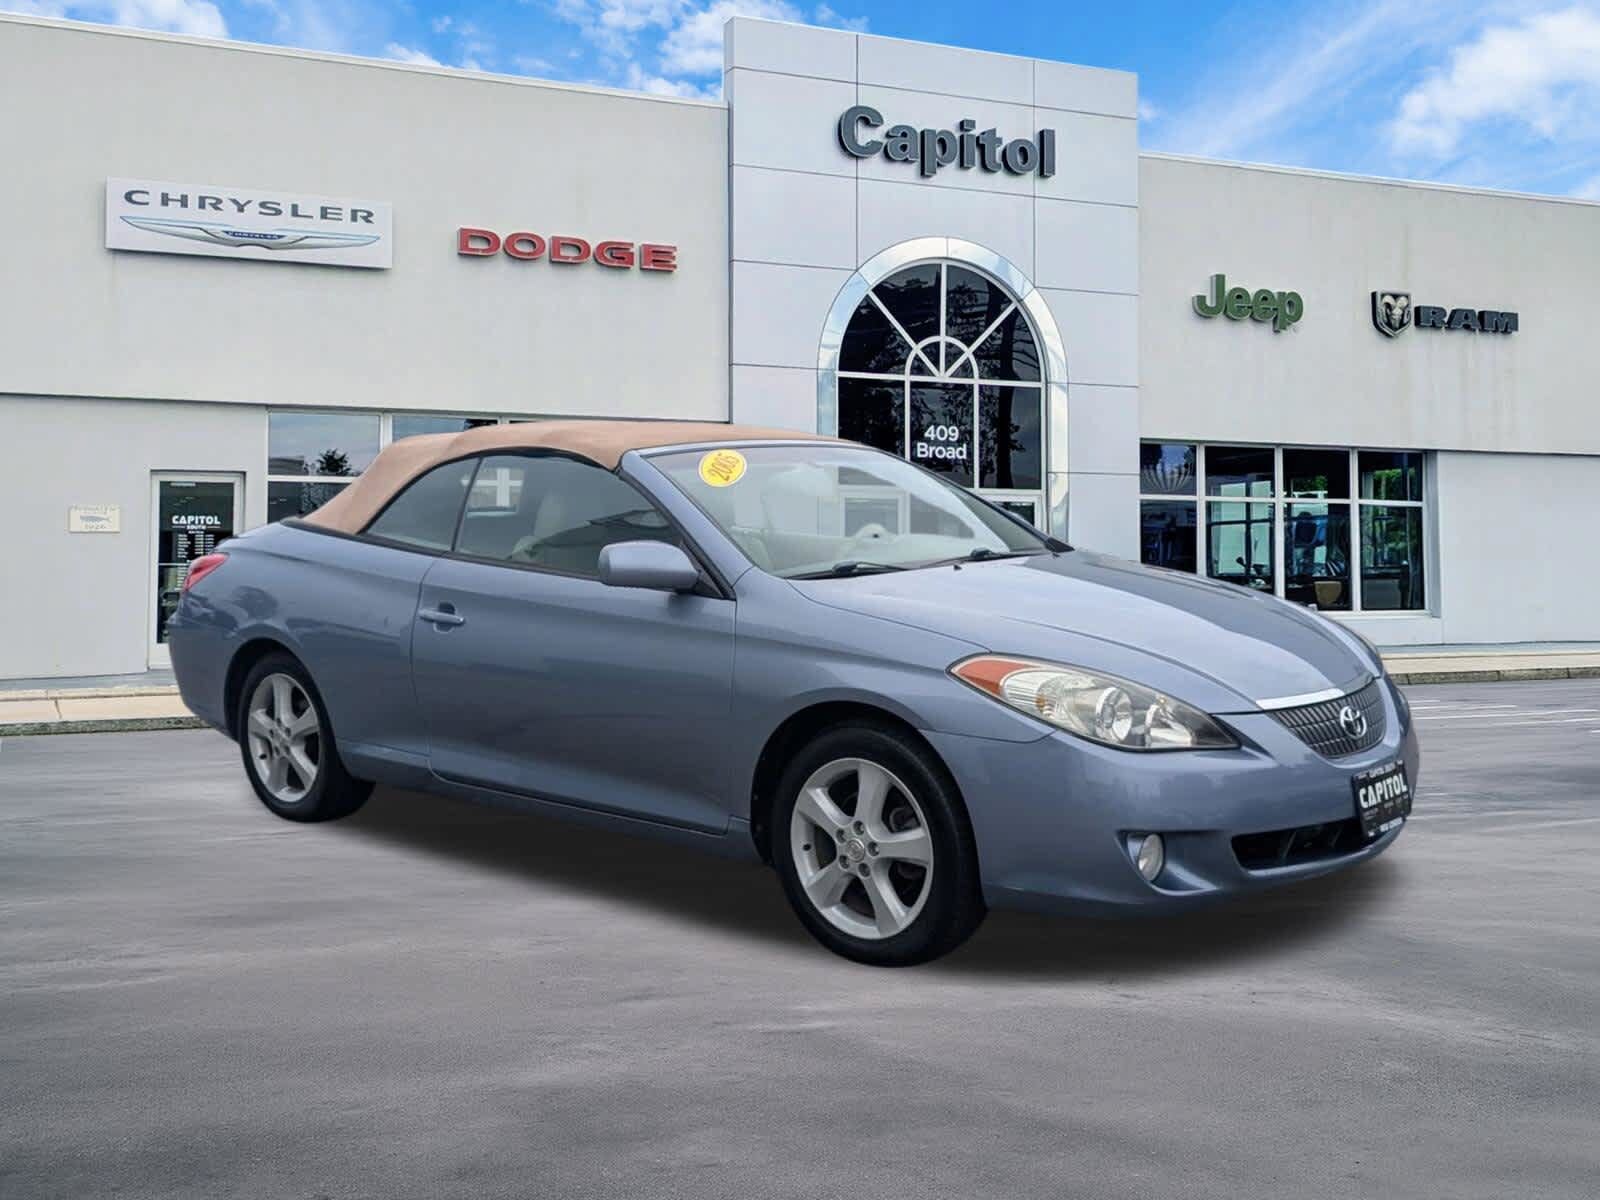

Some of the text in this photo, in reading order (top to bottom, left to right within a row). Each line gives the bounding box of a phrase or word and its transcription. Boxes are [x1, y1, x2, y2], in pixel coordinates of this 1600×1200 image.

[839, 105, 1055, 176] Capitol
[124, 190, 374, 223] CHRYSLER
[457, 227, 677, 271] DODGE
[1192, 274, 1304, 333] Jeep
[1415, 305, 1519, 333] RAM
[924, 425, 959, 441] 409
[917, 442, 967, 459] Broad
[172, 515, 221, 525] CAPITOL
[1360, 773, 1407, 808] CAPITOL
